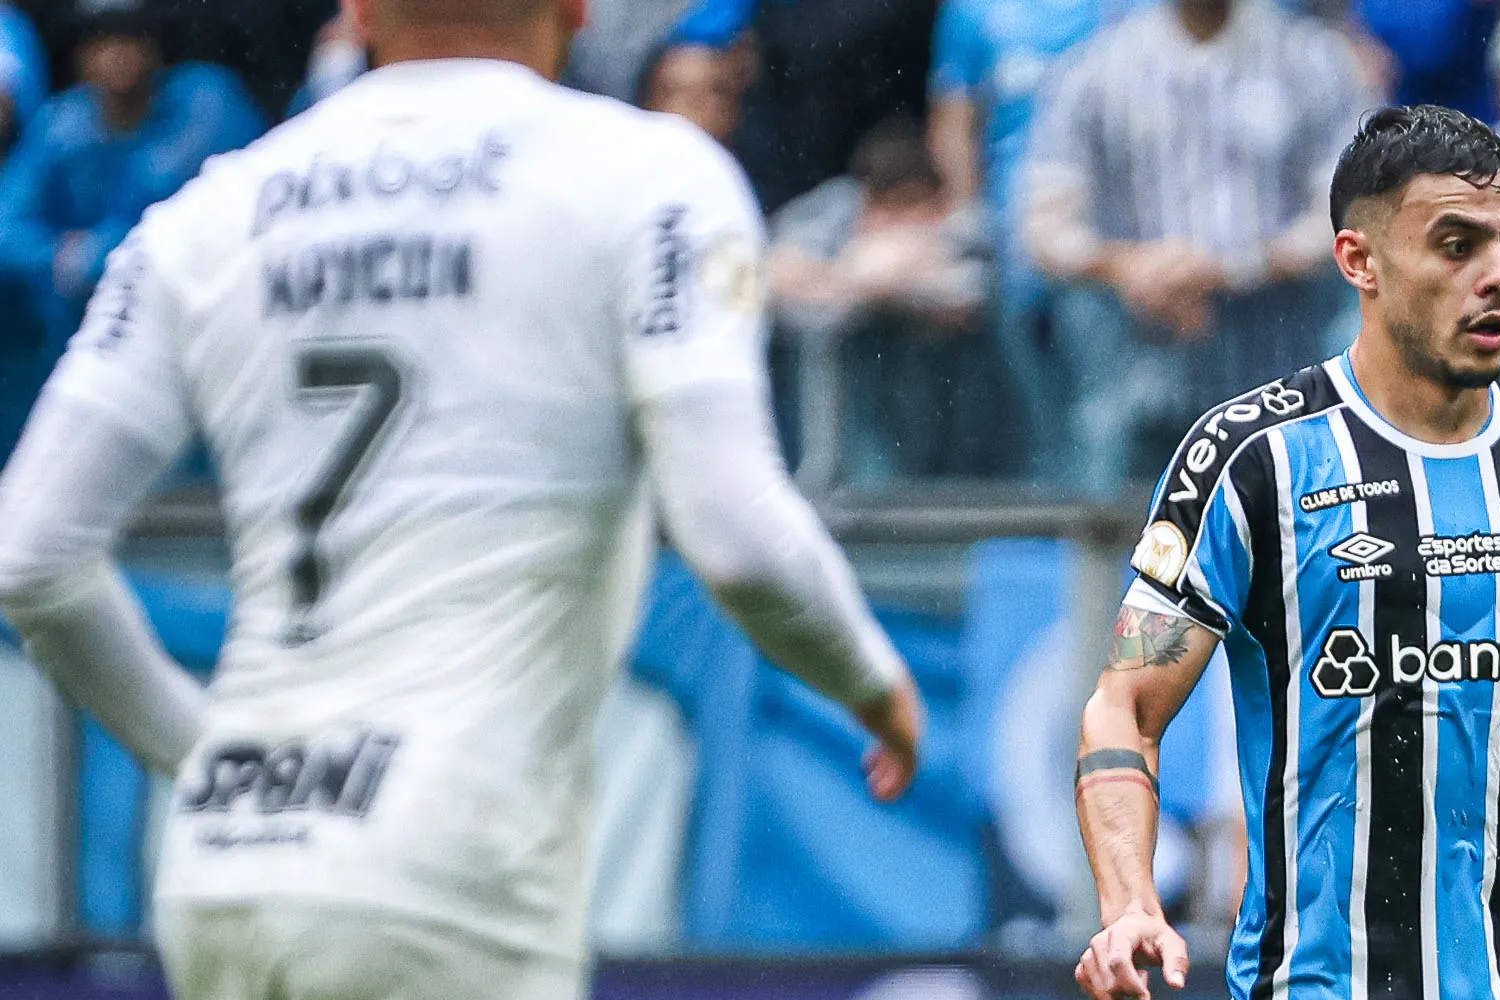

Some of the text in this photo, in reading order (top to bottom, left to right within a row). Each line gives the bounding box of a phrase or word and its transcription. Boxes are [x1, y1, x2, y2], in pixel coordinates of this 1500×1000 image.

[290, 336, 420, 615] 7
[1168, 403, 1261, 503] vero
[1300, 479, 1400, 510] CLUBE DE TODOS
[1340, 563, 1392, 580] umbro
